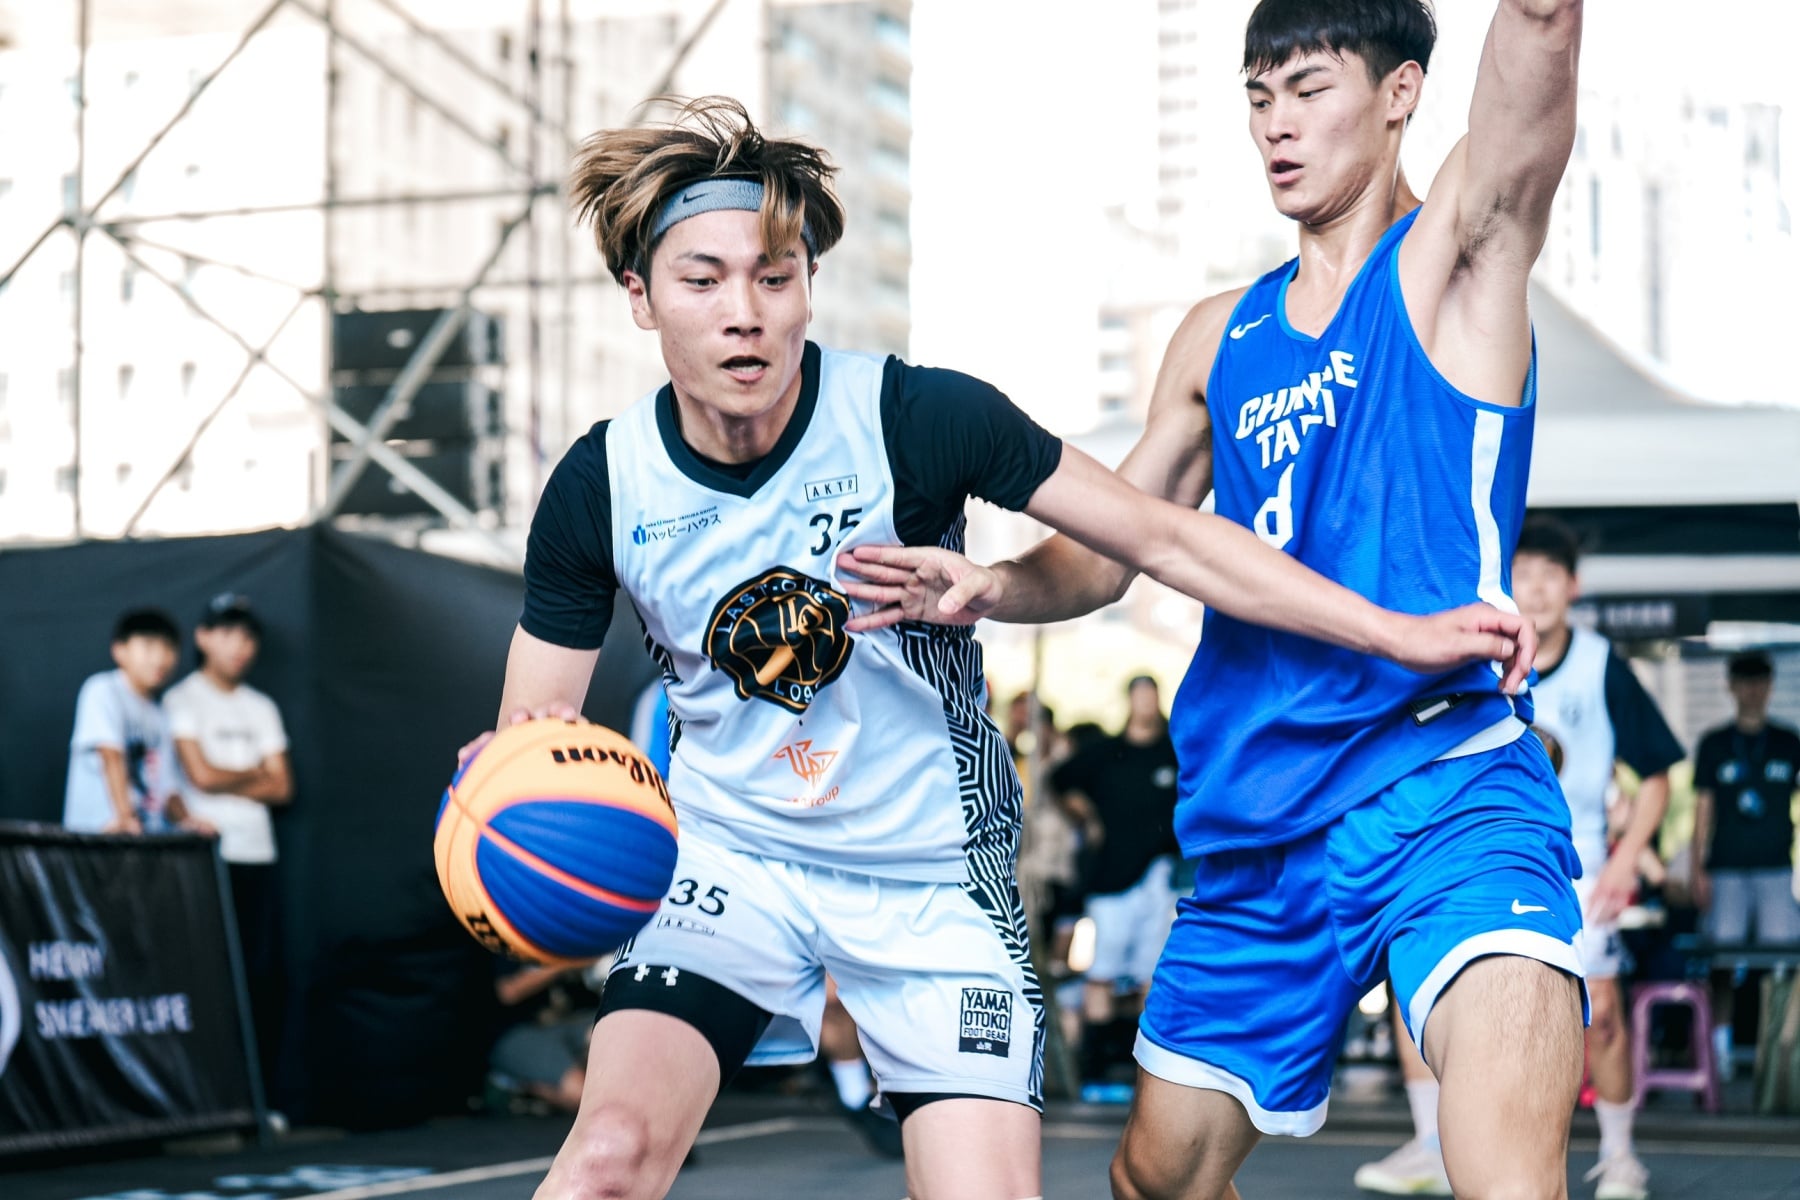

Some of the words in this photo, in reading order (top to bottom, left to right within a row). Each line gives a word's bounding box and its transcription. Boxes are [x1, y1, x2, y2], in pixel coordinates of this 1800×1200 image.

[647, 514, 721, 542] ハッピーハウス
[668, 878, 729, 920] 35
[137, 992, 191, 1034] LIFE
[965, 991, 1008, 1012] YAMA
[964, 1010, 1007, 1029] OTOKO
[963, 1028, 983, 1036] FOOT
[986, 1030, 1006, 1040] GEAR
